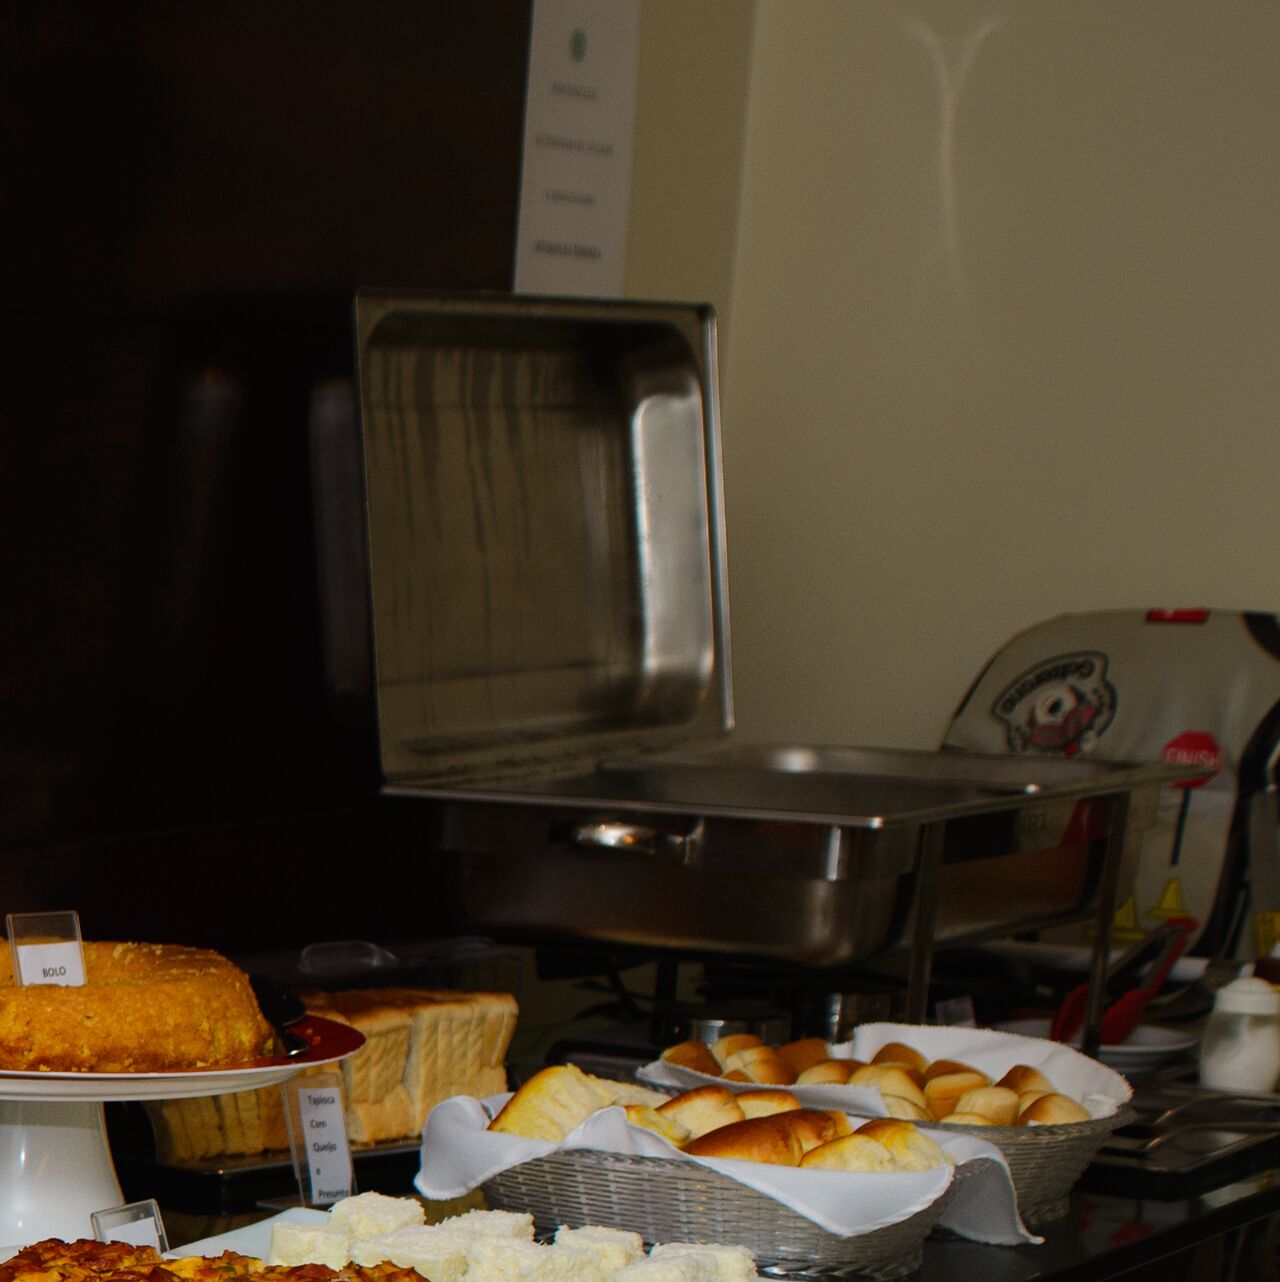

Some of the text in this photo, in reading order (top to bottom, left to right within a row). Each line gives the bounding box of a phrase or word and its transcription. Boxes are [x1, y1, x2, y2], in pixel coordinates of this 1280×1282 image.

[42, 966, 67, 977] BOLO
[307, 1095, 336, 1106] Tapioca
[310, 1119, 327, 1129] Com
[313, 1142, 337, 1153] Queijo
